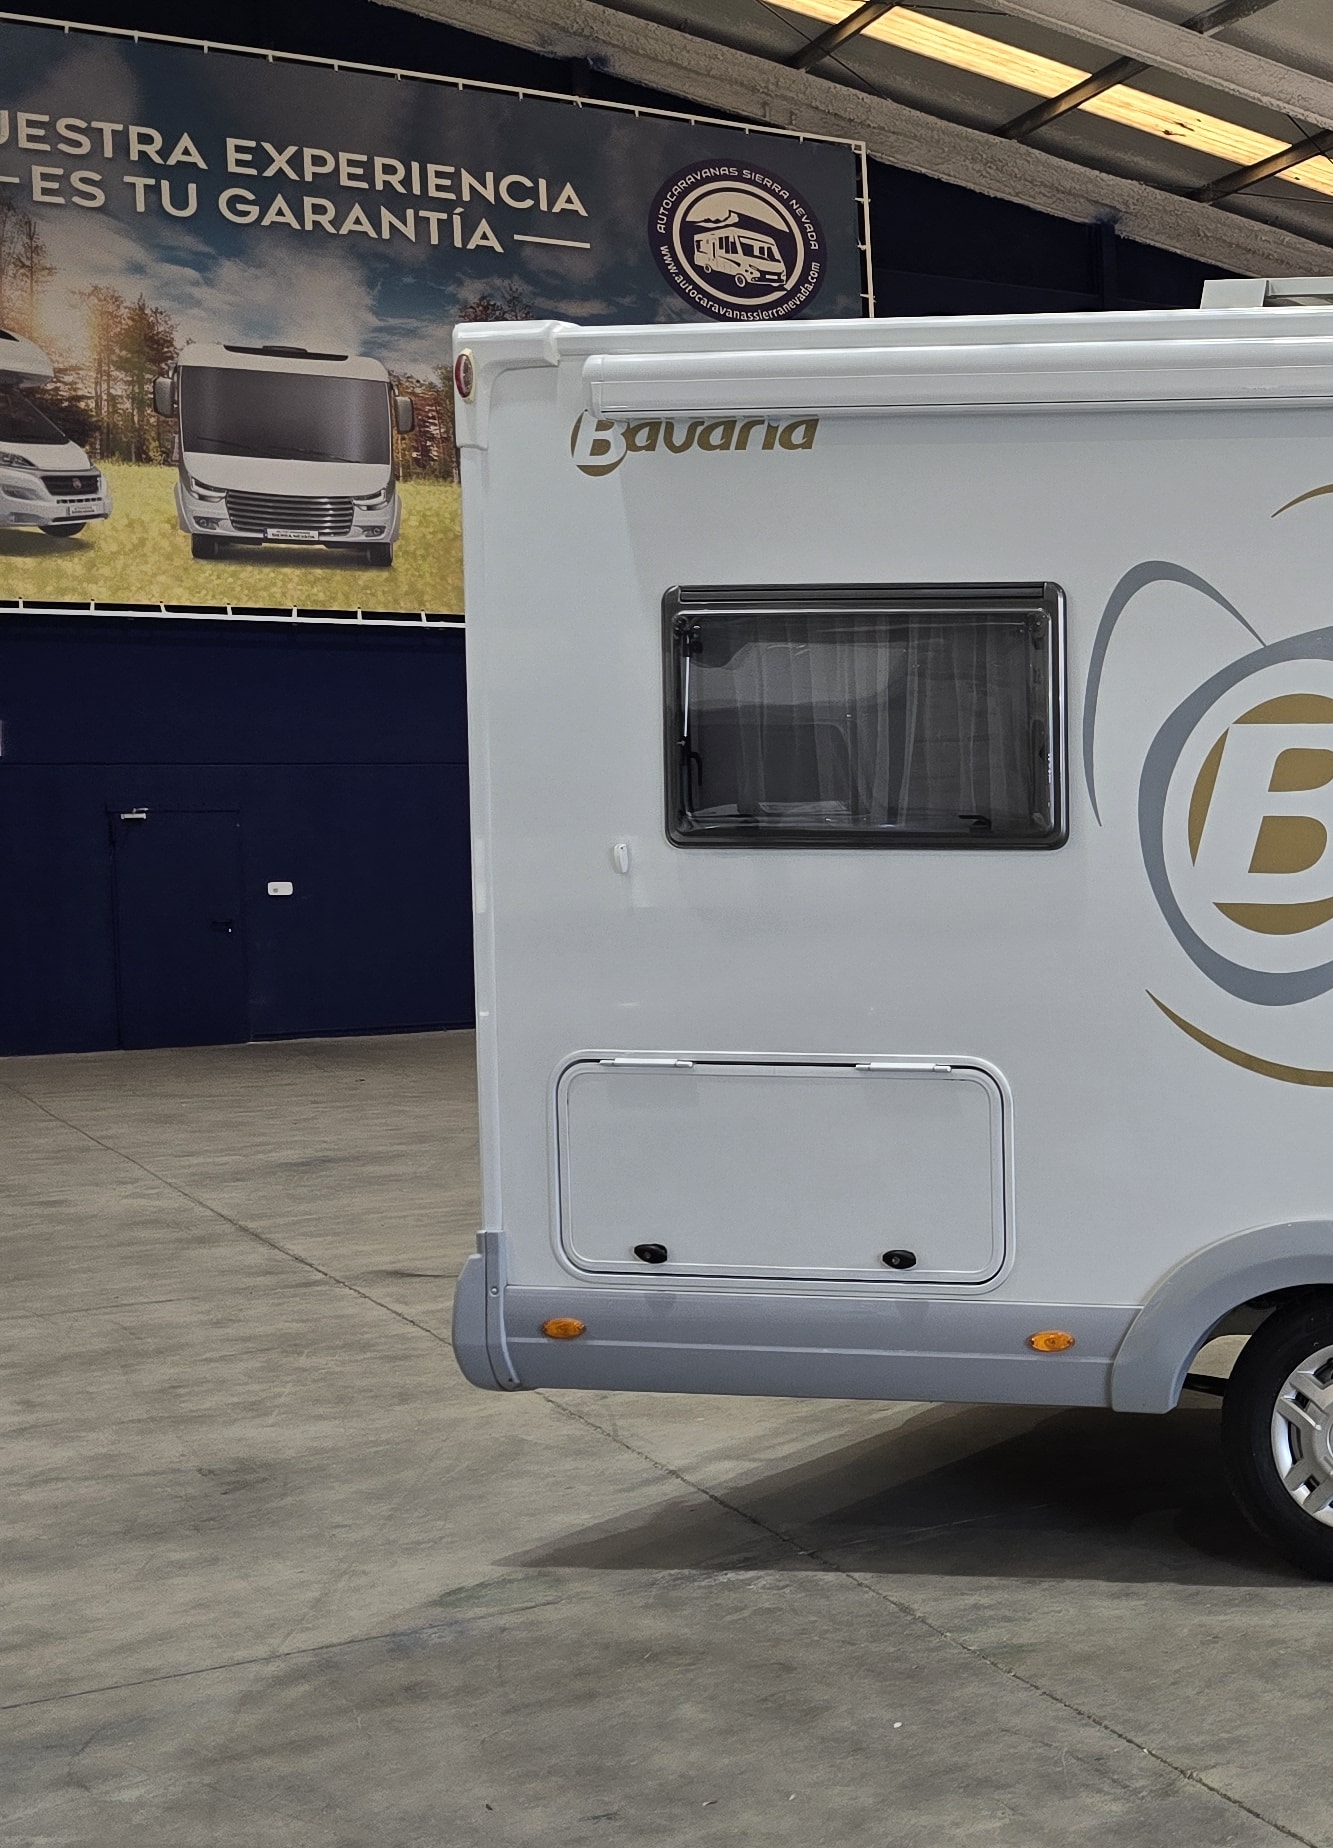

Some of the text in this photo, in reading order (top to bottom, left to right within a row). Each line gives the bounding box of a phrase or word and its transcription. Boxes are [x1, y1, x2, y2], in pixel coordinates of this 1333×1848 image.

[0, 110, 588, 217] ESTRA EXPERIENCIA
[31, 165, 504, 253] ES TU GARANTÍA
[656, 166, 819, 250] AUTOCARAVANAS SIERRA NEVADA
[660, 245, 821, 321] www.autocaravanassierranevada.com
[570, 409, 819, 477] Bavaria
